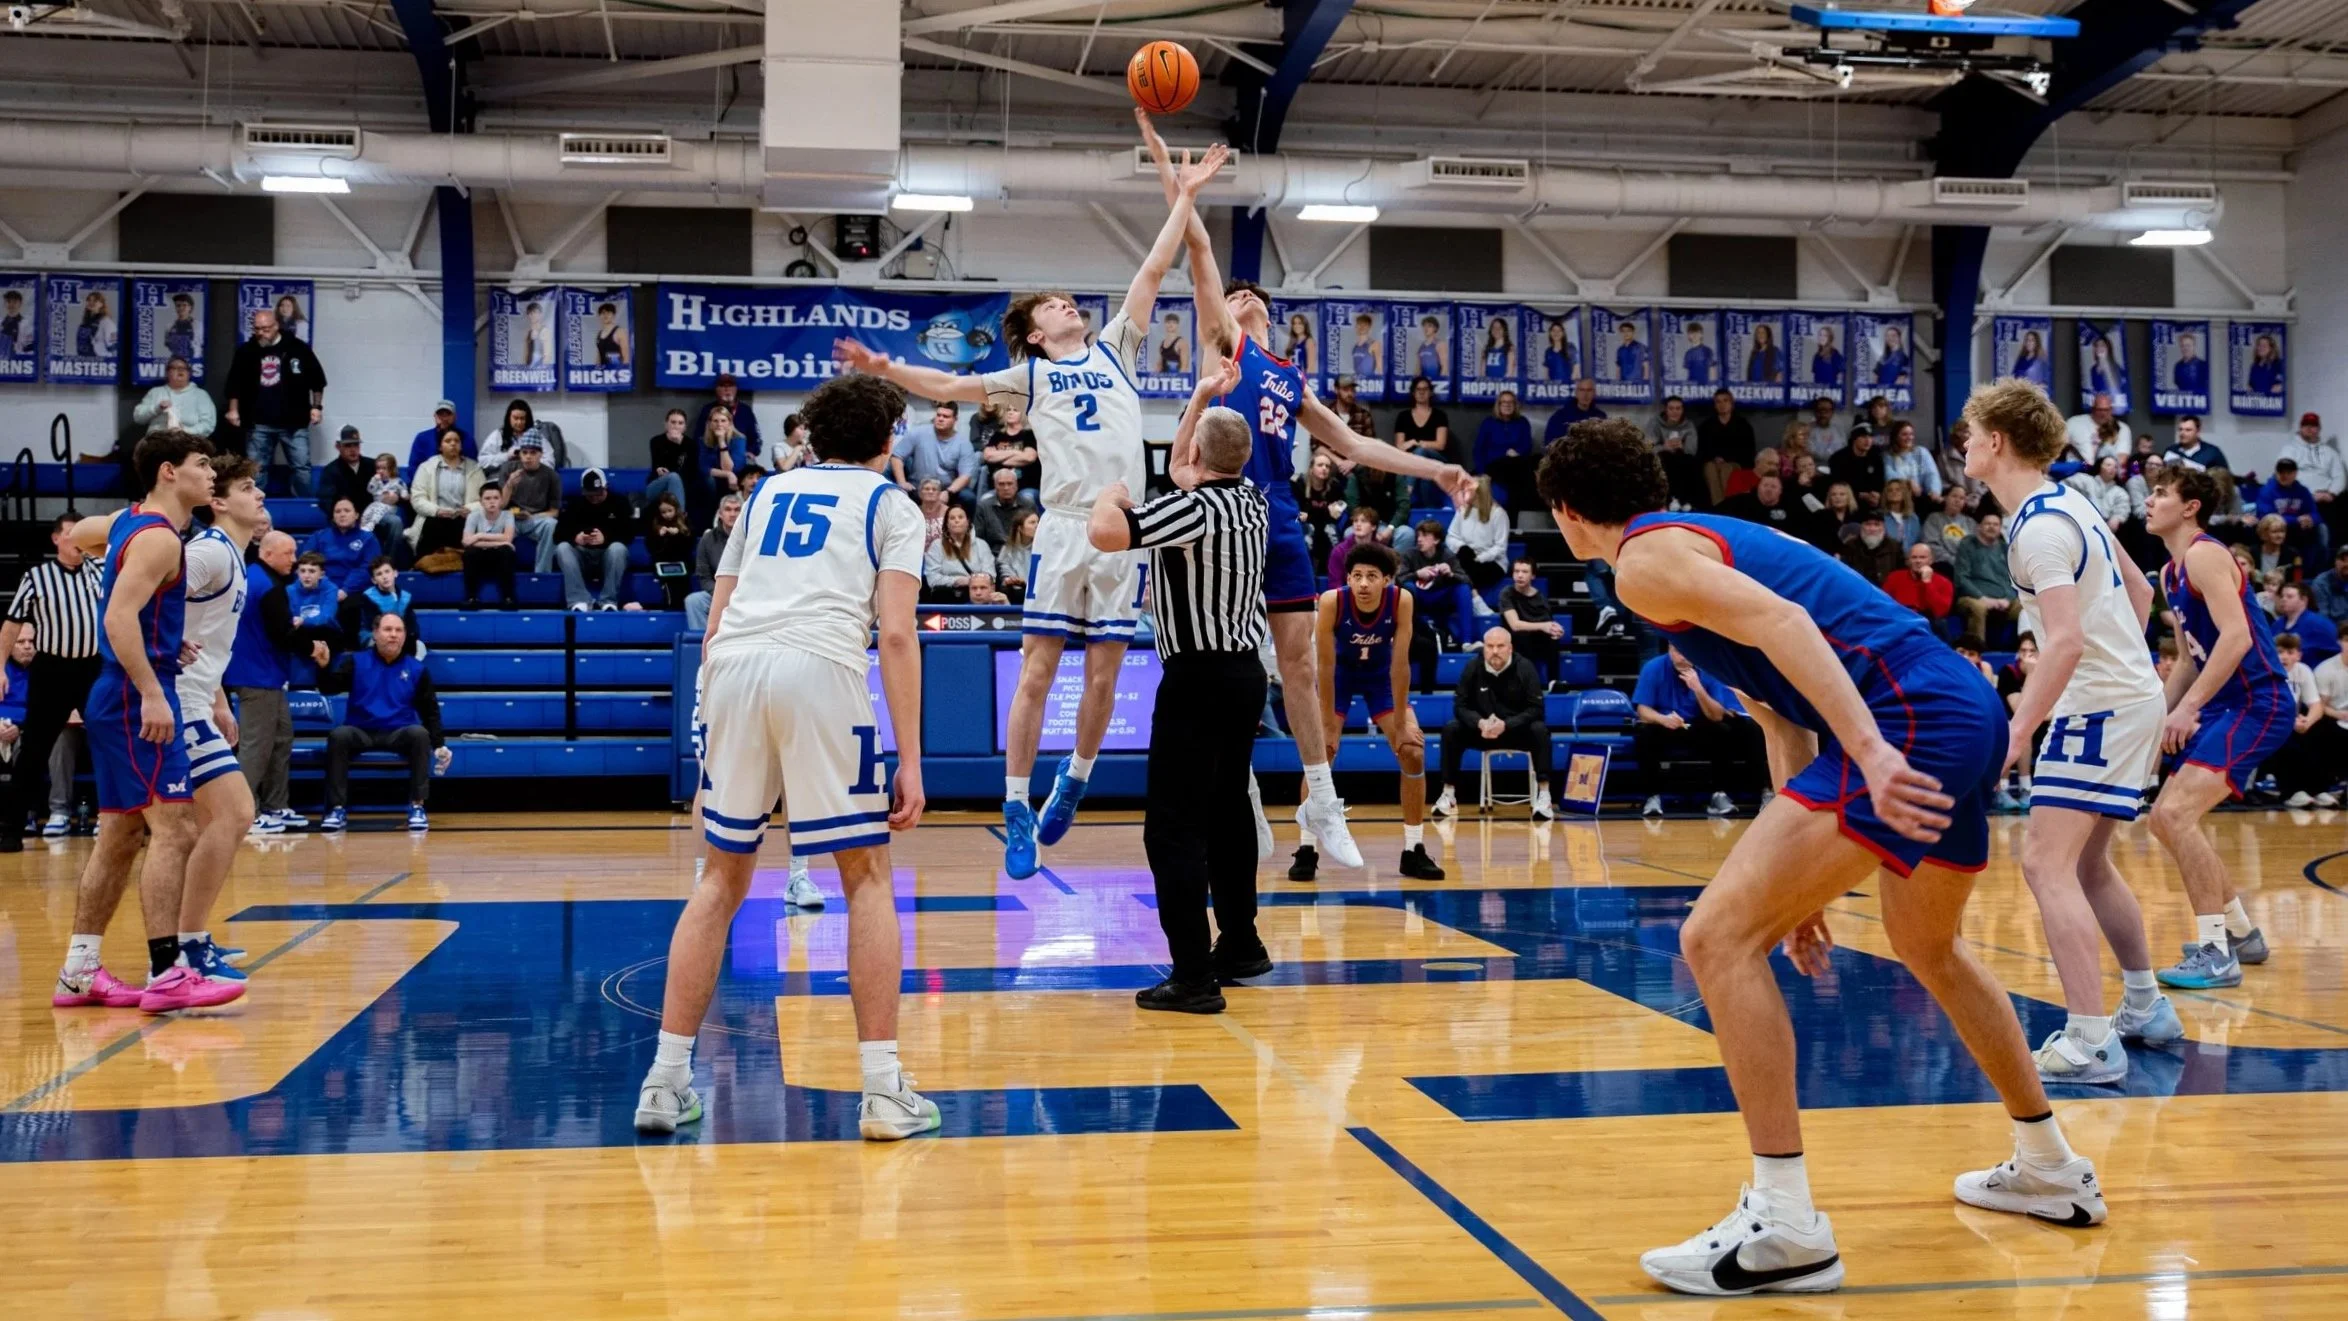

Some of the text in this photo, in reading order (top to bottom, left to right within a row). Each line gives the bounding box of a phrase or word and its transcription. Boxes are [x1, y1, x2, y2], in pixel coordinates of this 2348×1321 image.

[668, 293, 912, 332] HIGHLANDS
[49, 361, 117, 376] MASTERS
[138, 362, 204, 377] WIS
[665, 350, 906, 379] Bluebir
[494, 369, 557, 384] GREENWELL
[569, 370, 632, 385] HICKS
[1138, 378, 1193, 391] VOTEL
[1260, 370, 1295, 402] Tribe
[1394, 380, 1450, 394] UZ
[1664, 385, 1718, 398] KEARNS
[2154, 393, 2206, 408] VEITH
[1073, 393, 1101, 431] 2
[759, 493, 839, 558] 15
[941, 617, 970, 629] POSS
[1350, 633, 1383, 645] Tribe
[1360, 647, 1369, 660] 1
